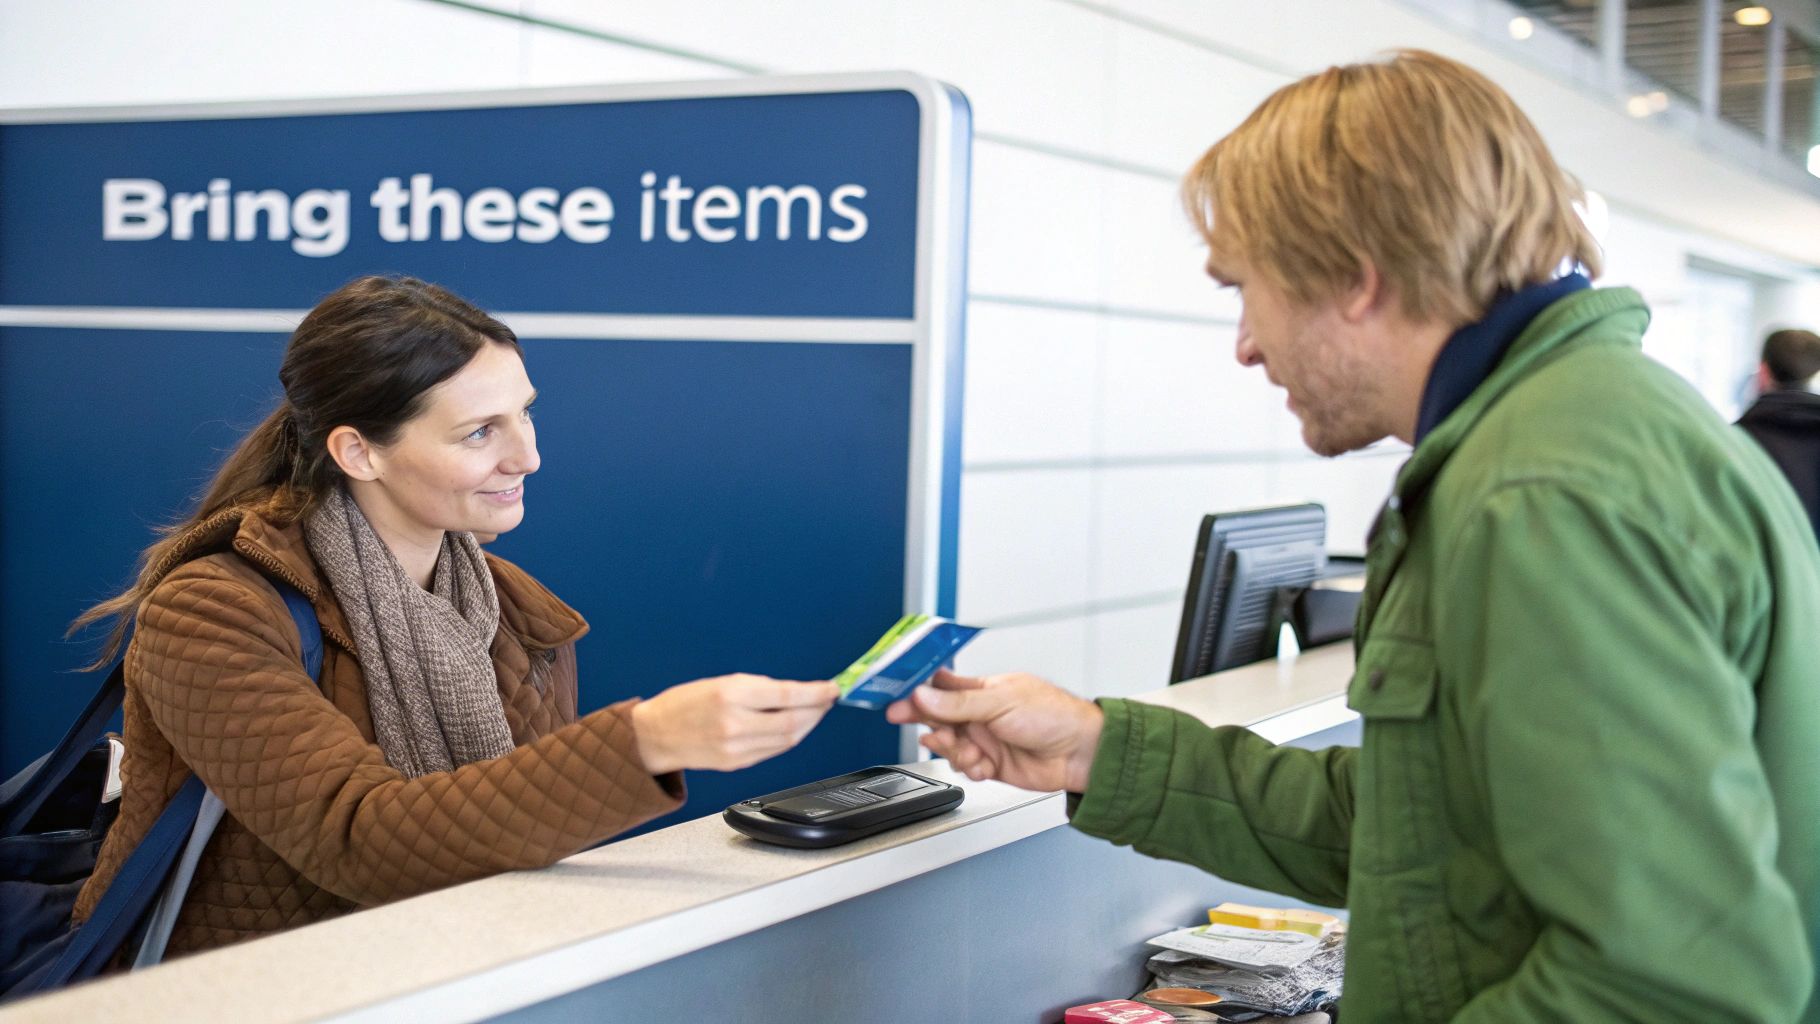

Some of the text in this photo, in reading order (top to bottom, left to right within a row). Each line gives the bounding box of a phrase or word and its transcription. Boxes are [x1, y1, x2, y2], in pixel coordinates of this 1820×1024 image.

[102, 172, 868, 257] Bring these items
